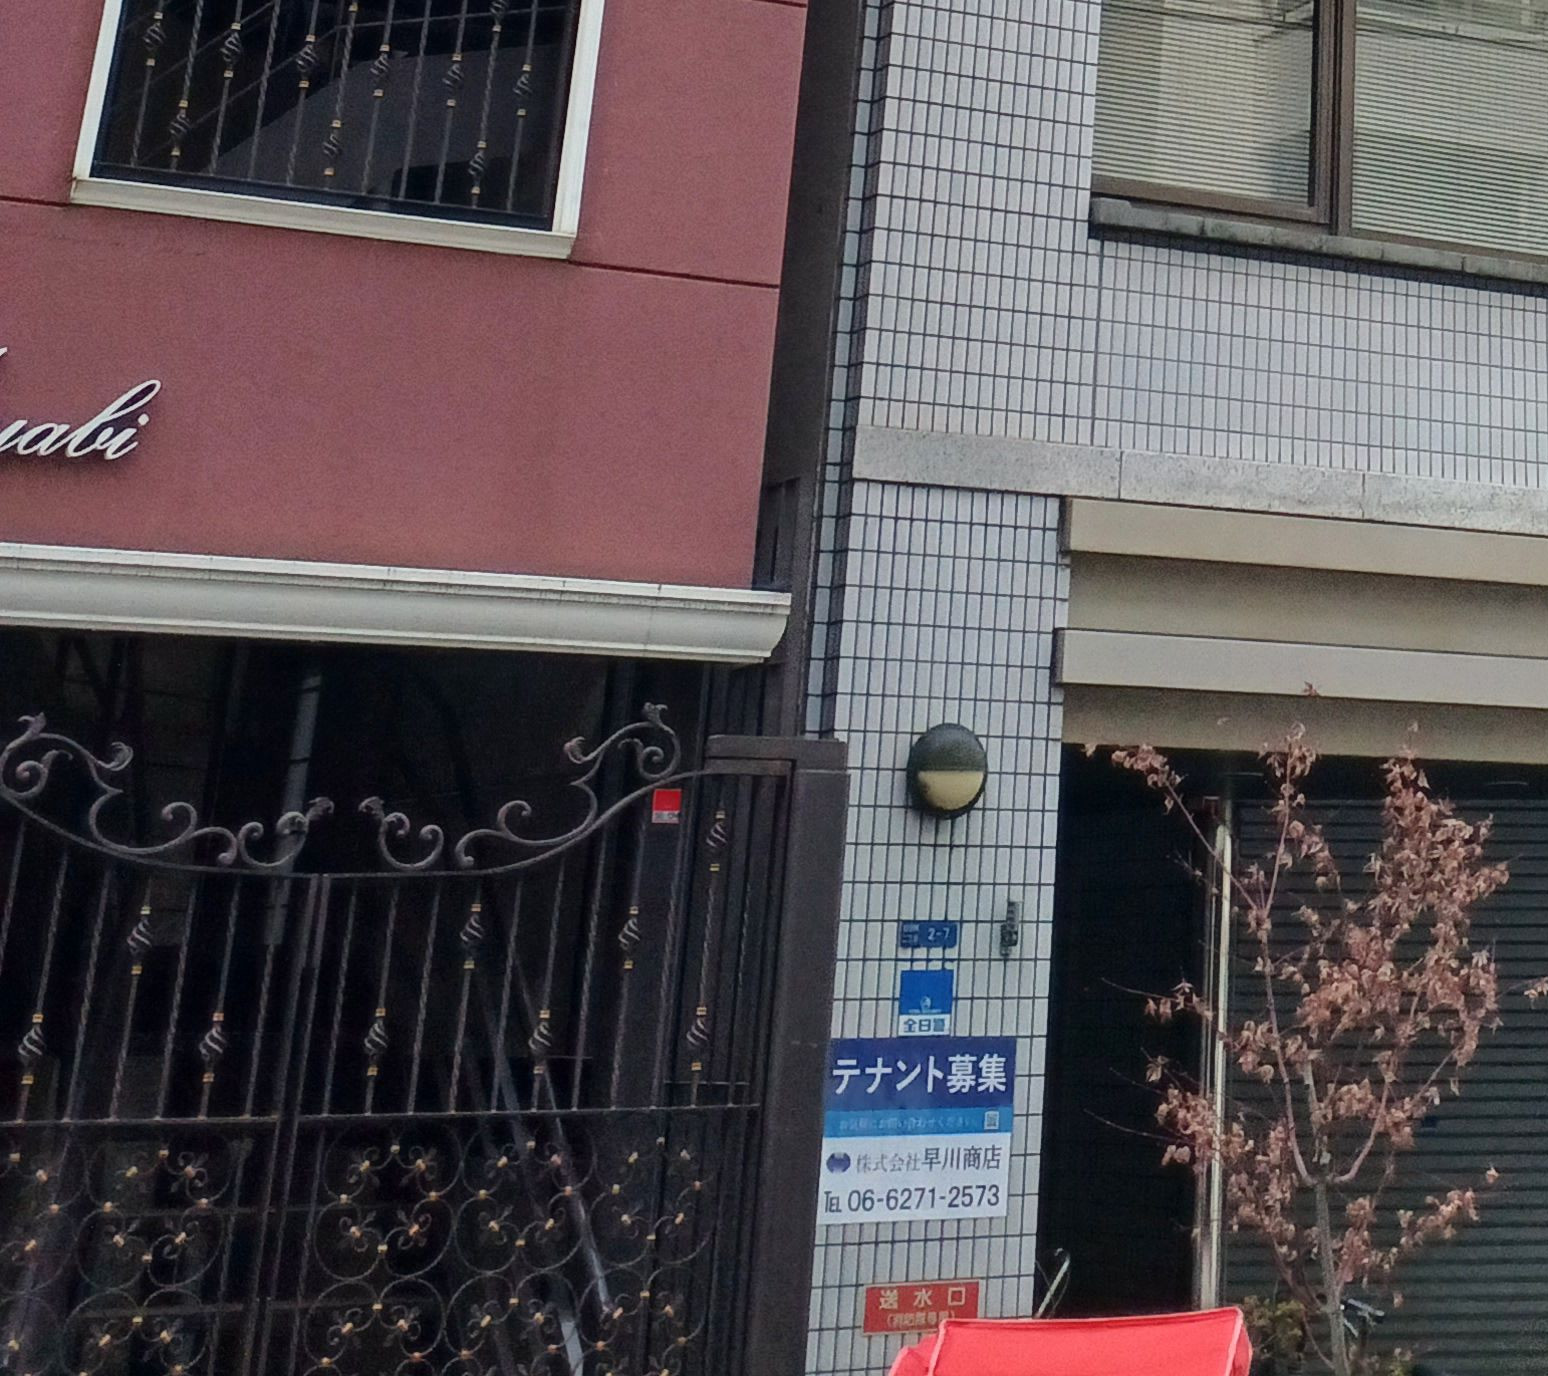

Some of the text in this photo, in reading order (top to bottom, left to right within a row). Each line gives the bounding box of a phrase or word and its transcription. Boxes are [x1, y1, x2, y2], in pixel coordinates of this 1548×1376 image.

[832, 1053, 1007, 1095] テナント募集
[847, 1184, 1000, 1213] 06-6271-2573
[879, 1286, 966, 1310] 送水口
